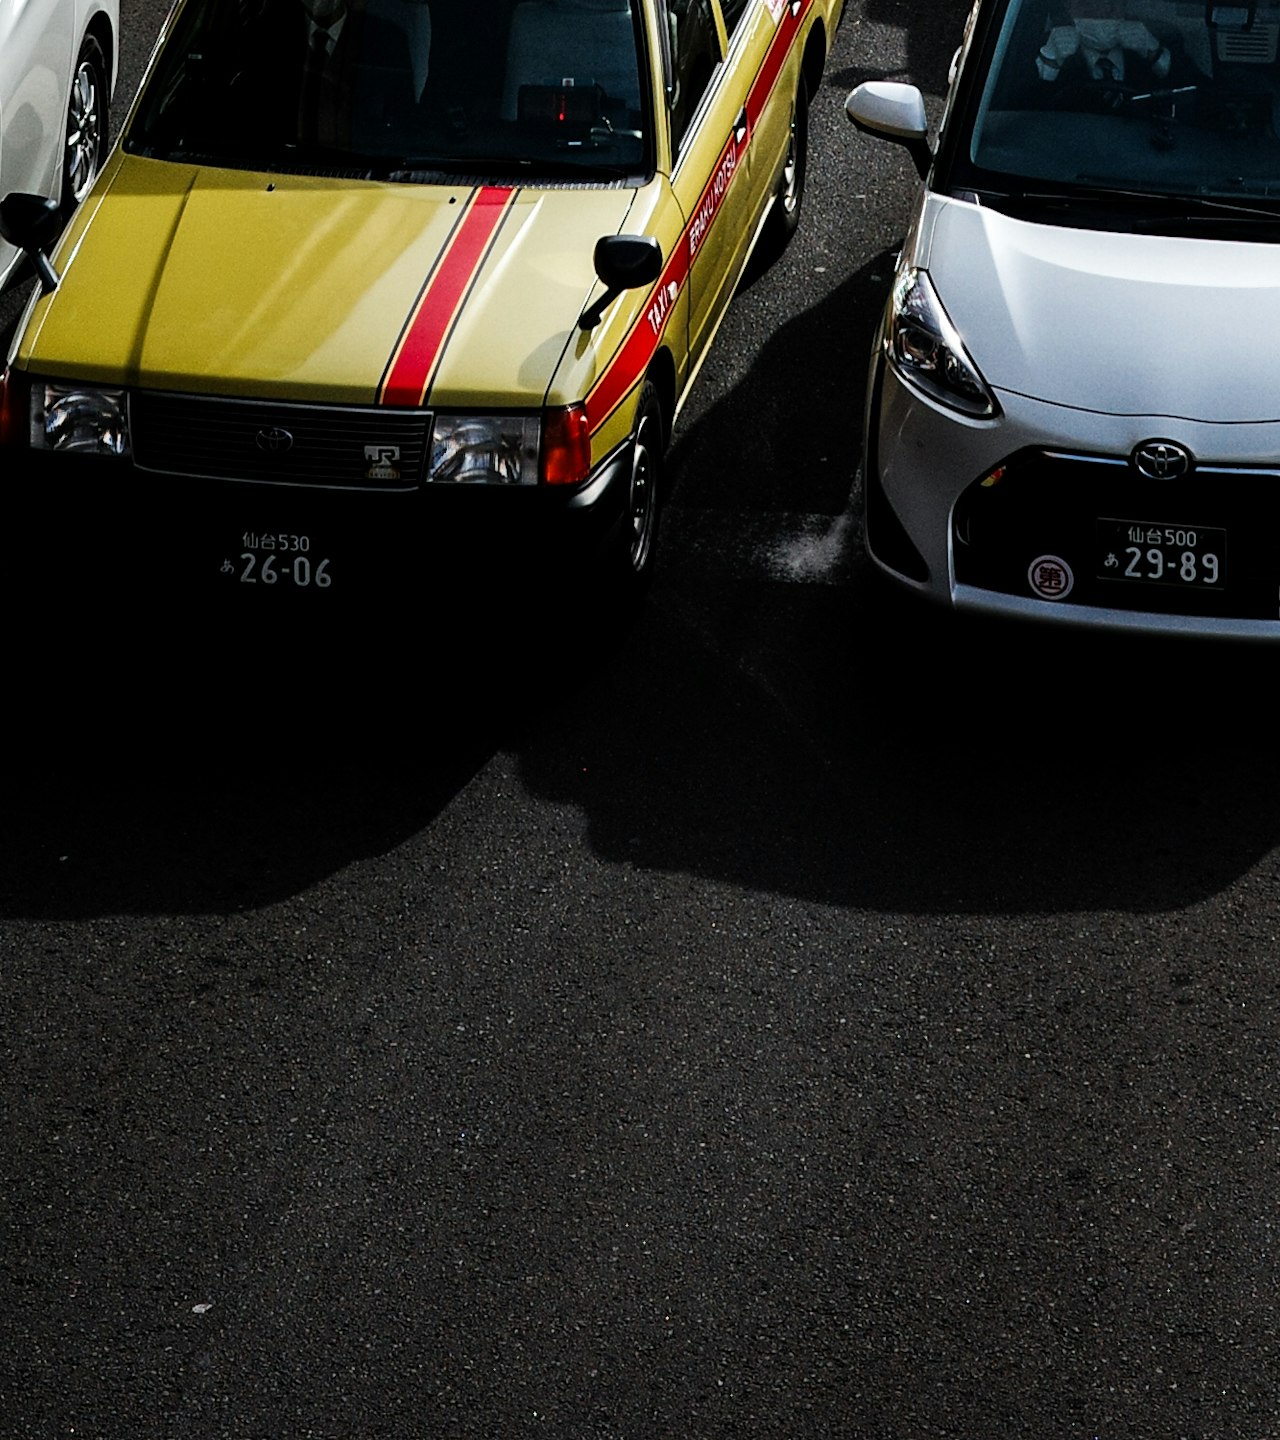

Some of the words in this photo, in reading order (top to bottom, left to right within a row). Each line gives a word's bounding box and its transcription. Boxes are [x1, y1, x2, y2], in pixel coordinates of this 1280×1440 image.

[711, 145, 738, 210] KOTSU
[647, 290, 671, 334] TAXI
[242, 531, 310, 553] 仙台530
[1126, 525, 1197, 548] 仙台500
[220, 559, 236, 576] あ
[239, 551, 333, 590] 26-06
[1103, 552, 1121, 570] あ
[1124, 546, 1221, 586] 29-89
